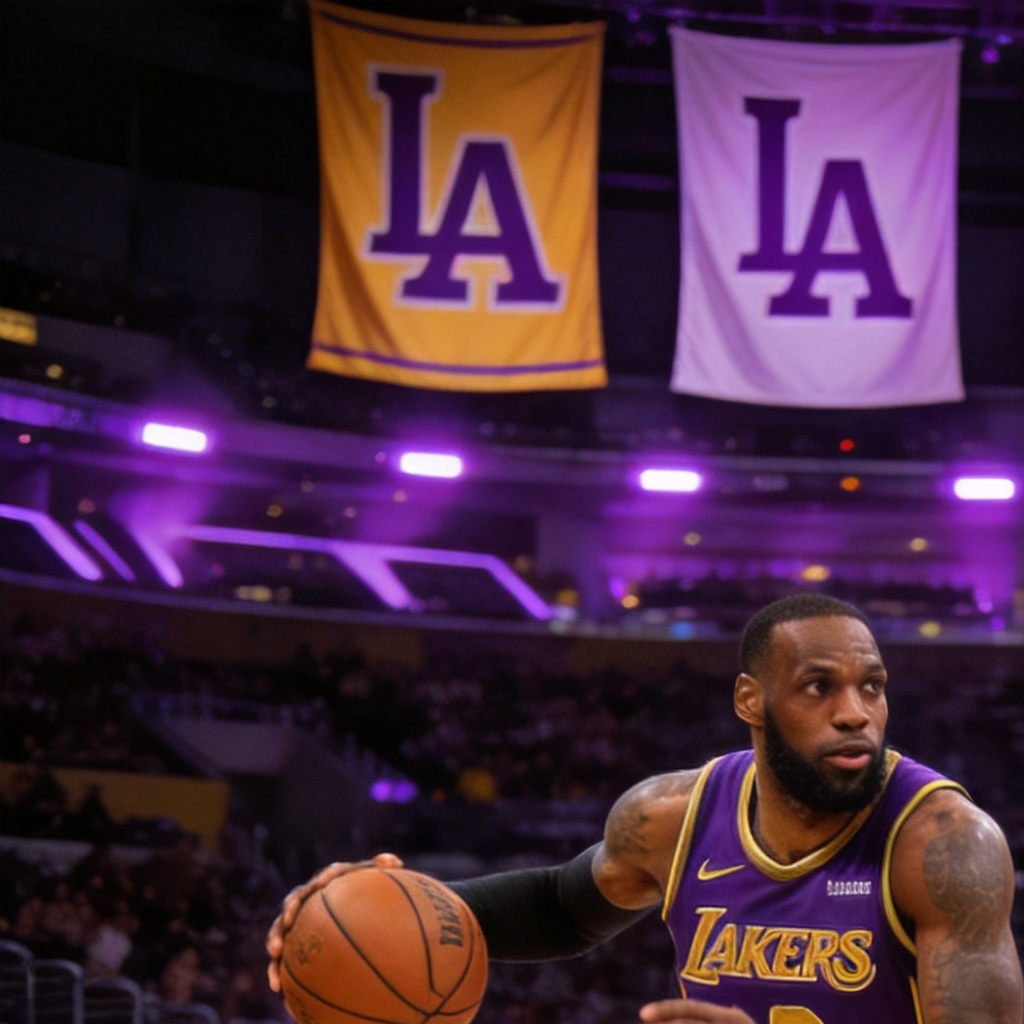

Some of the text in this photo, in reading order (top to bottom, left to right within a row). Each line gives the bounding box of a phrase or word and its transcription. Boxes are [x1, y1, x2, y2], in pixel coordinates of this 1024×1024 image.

[365, 66, 565, 311] LA
[737, 96, 914, 319] LA
[680, 907, 877, 992] LAKERS
